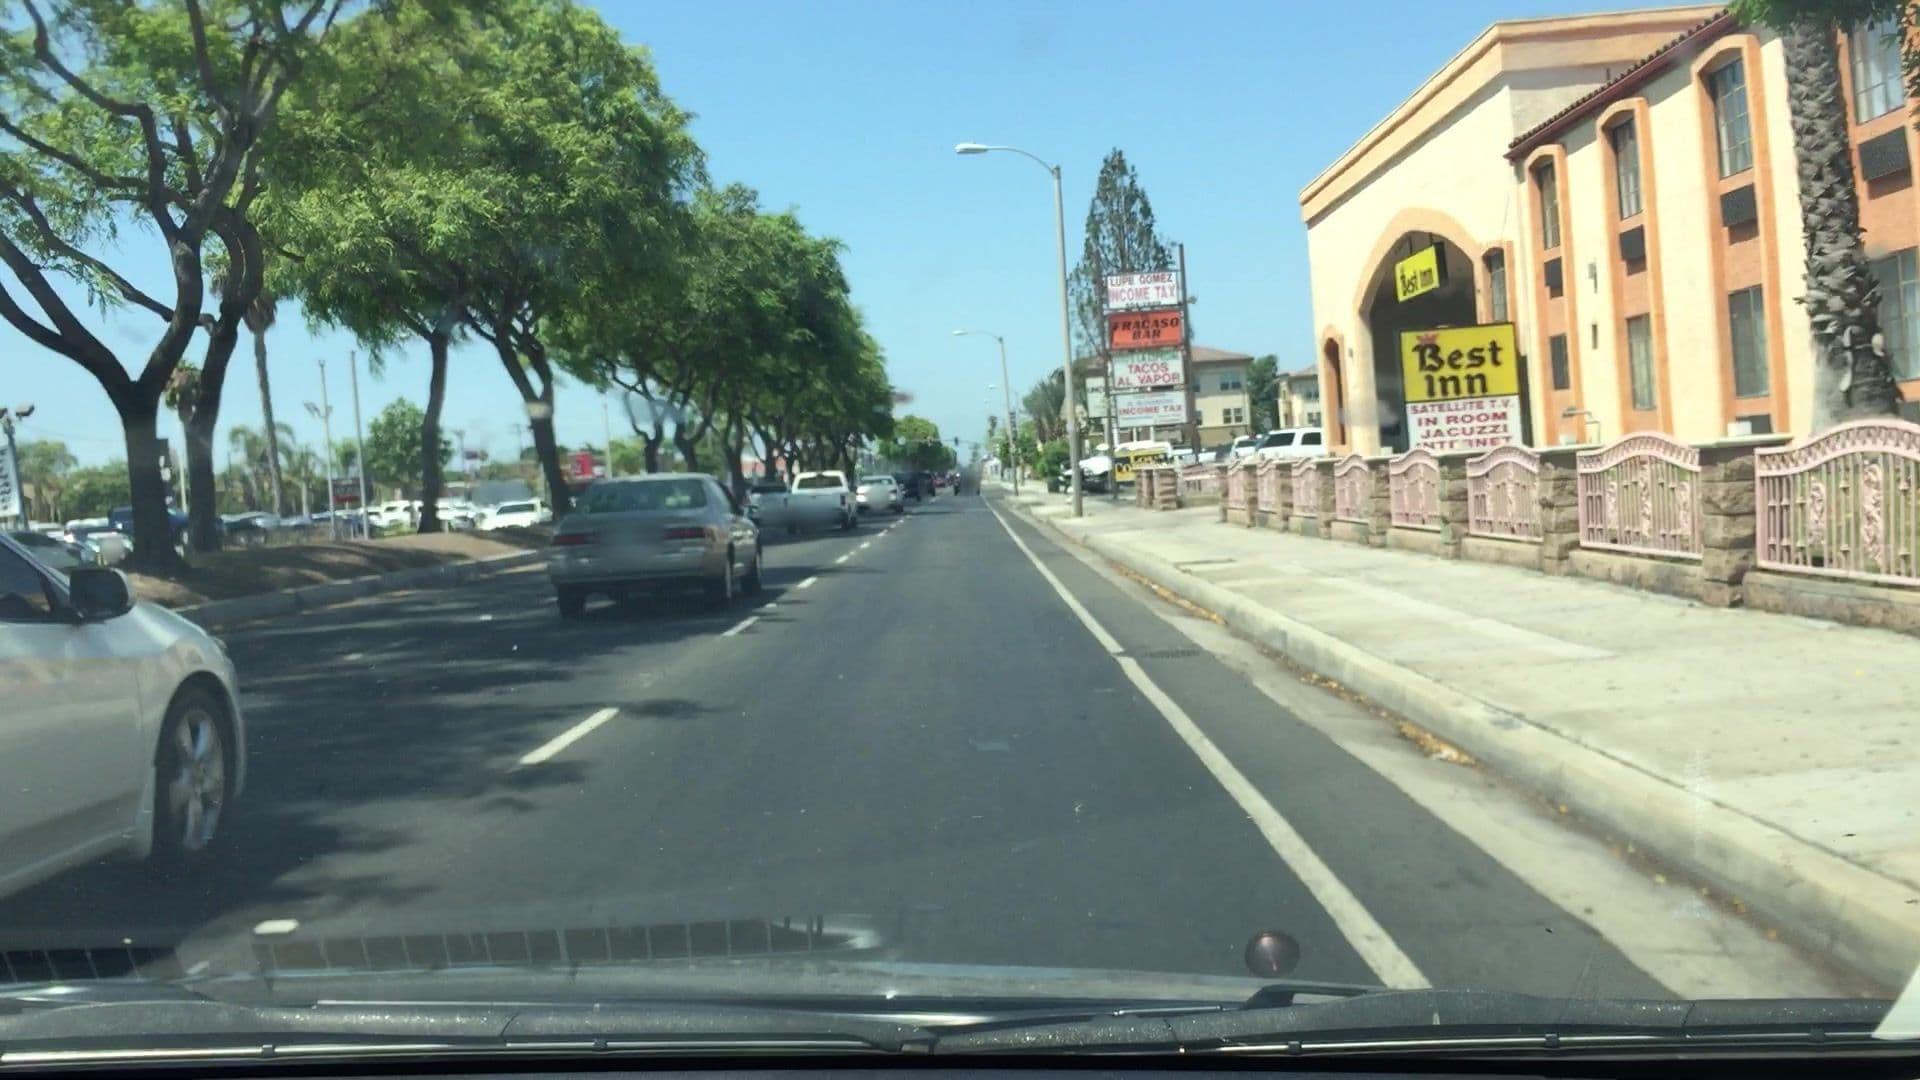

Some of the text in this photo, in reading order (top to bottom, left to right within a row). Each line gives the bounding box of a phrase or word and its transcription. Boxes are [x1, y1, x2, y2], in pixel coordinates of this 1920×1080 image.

[1110, 272, 1173, 287] LUPE GOMEZ
[1110, 283, 1177, 302] INCOME TAX
[1111, 316, 1179, 332] FRACASO
[1132, 329, 1161, 340] BAR
[1411, 339, 1503, 372] Best
[1127, 362, 1169, 374] TACOS
[1117, 373, 1181, 387] AL VAPOR
[1410, 399, 1484, 415] SATELLITE
[1417, 411, 1508, 427] IN ROOM
[1419, 423, 1509, 440] JACUZZI
